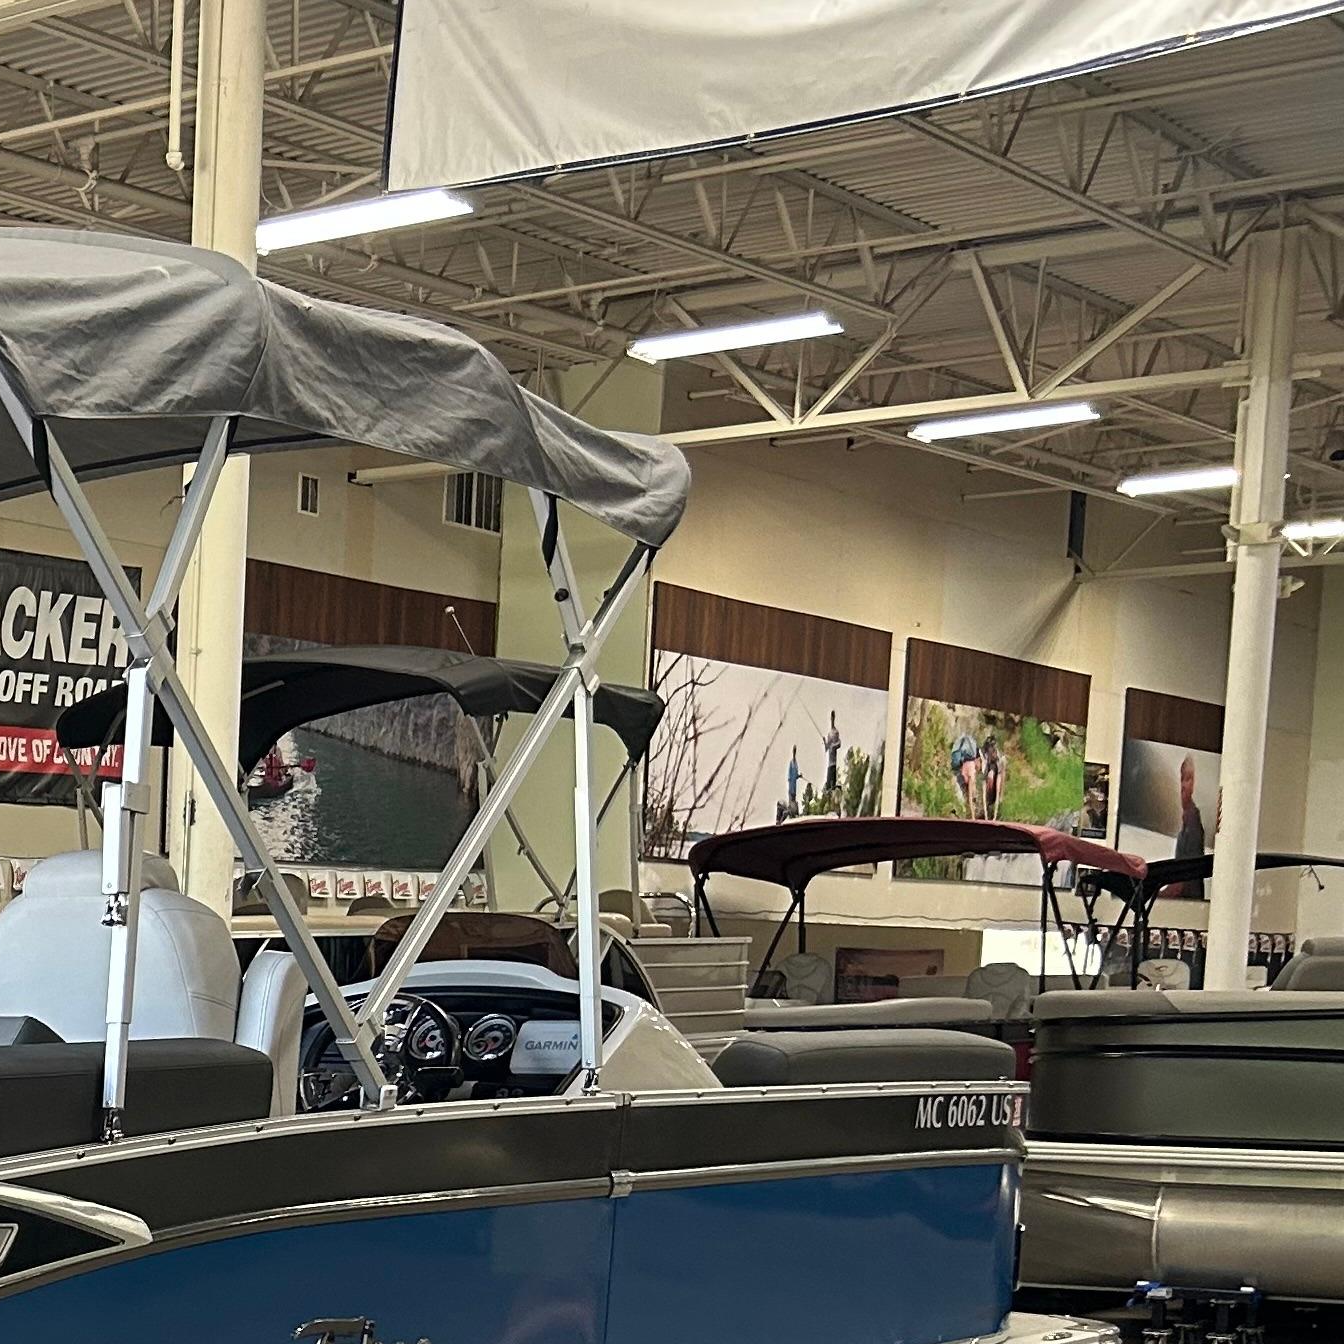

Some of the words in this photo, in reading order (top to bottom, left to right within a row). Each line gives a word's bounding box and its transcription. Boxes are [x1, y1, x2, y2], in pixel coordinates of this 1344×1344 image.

[54, 675, 124, 707] ROA
[32, 739, 52, 764] OF
[524, 1039, 580, 1051] GARMIN
[914, 1096, 945, 1128] MC
[947, 1095, 987, 1127] 6062
[992, 1094, 1012, 1125] US
